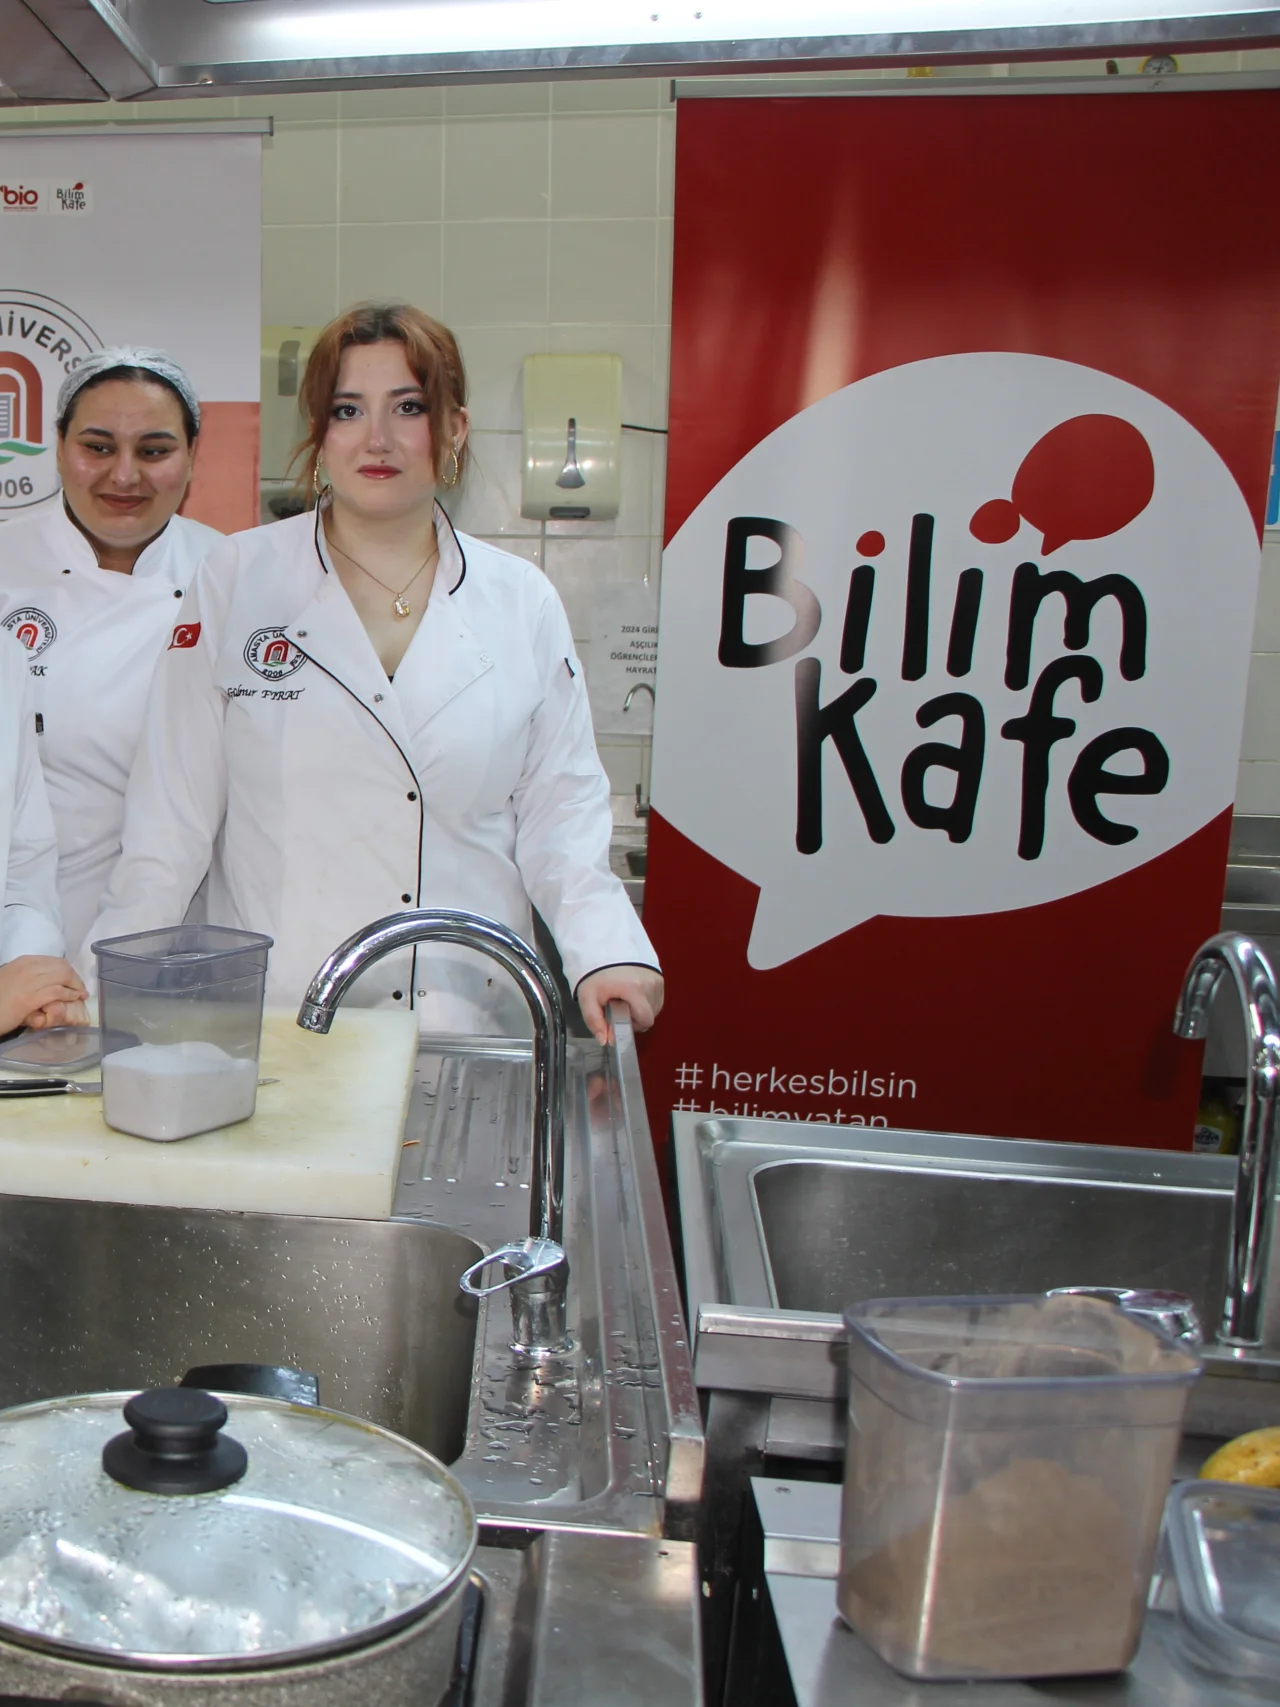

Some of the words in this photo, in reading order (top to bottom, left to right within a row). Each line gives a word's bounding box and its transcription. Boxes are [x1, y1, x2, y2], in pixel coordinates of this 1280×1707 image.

[56, 187, 85, 199] Bilim
[61, 198, 86, 211] Kafe
[718, 511, 1147, 691] Bilim
[6, 615, 22, 632] SYA
[621, 625, 640, 633] 2024
[794, 655, 1170, 861] Kafe
